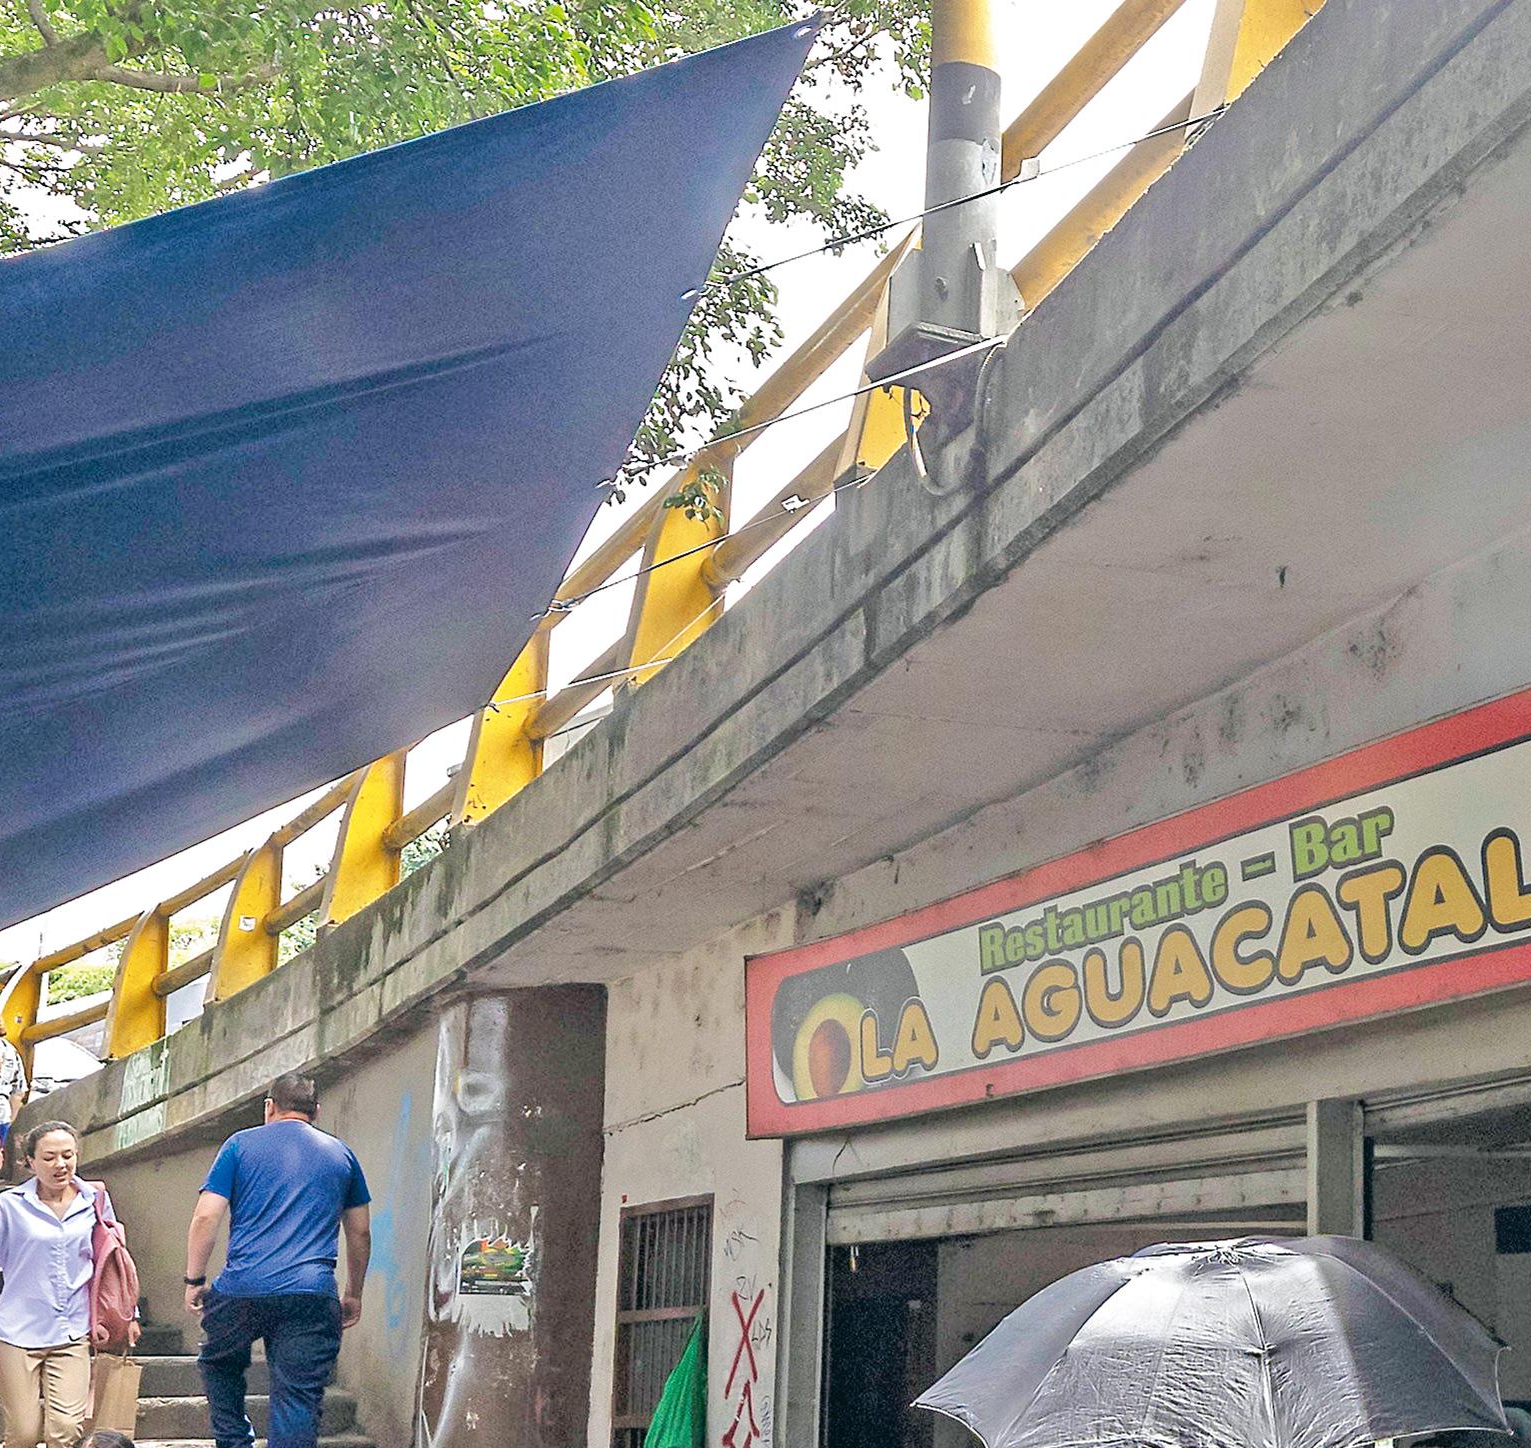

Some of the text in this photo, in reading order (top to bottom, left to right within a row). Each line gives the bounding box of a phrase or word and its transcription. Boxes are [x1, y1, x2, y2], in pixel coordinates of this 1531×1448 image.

[981, 859, 1228, 976] Restaurante
[1289, 805, 1394, 882] Bar
[861, 998, 938, 1084] LA
